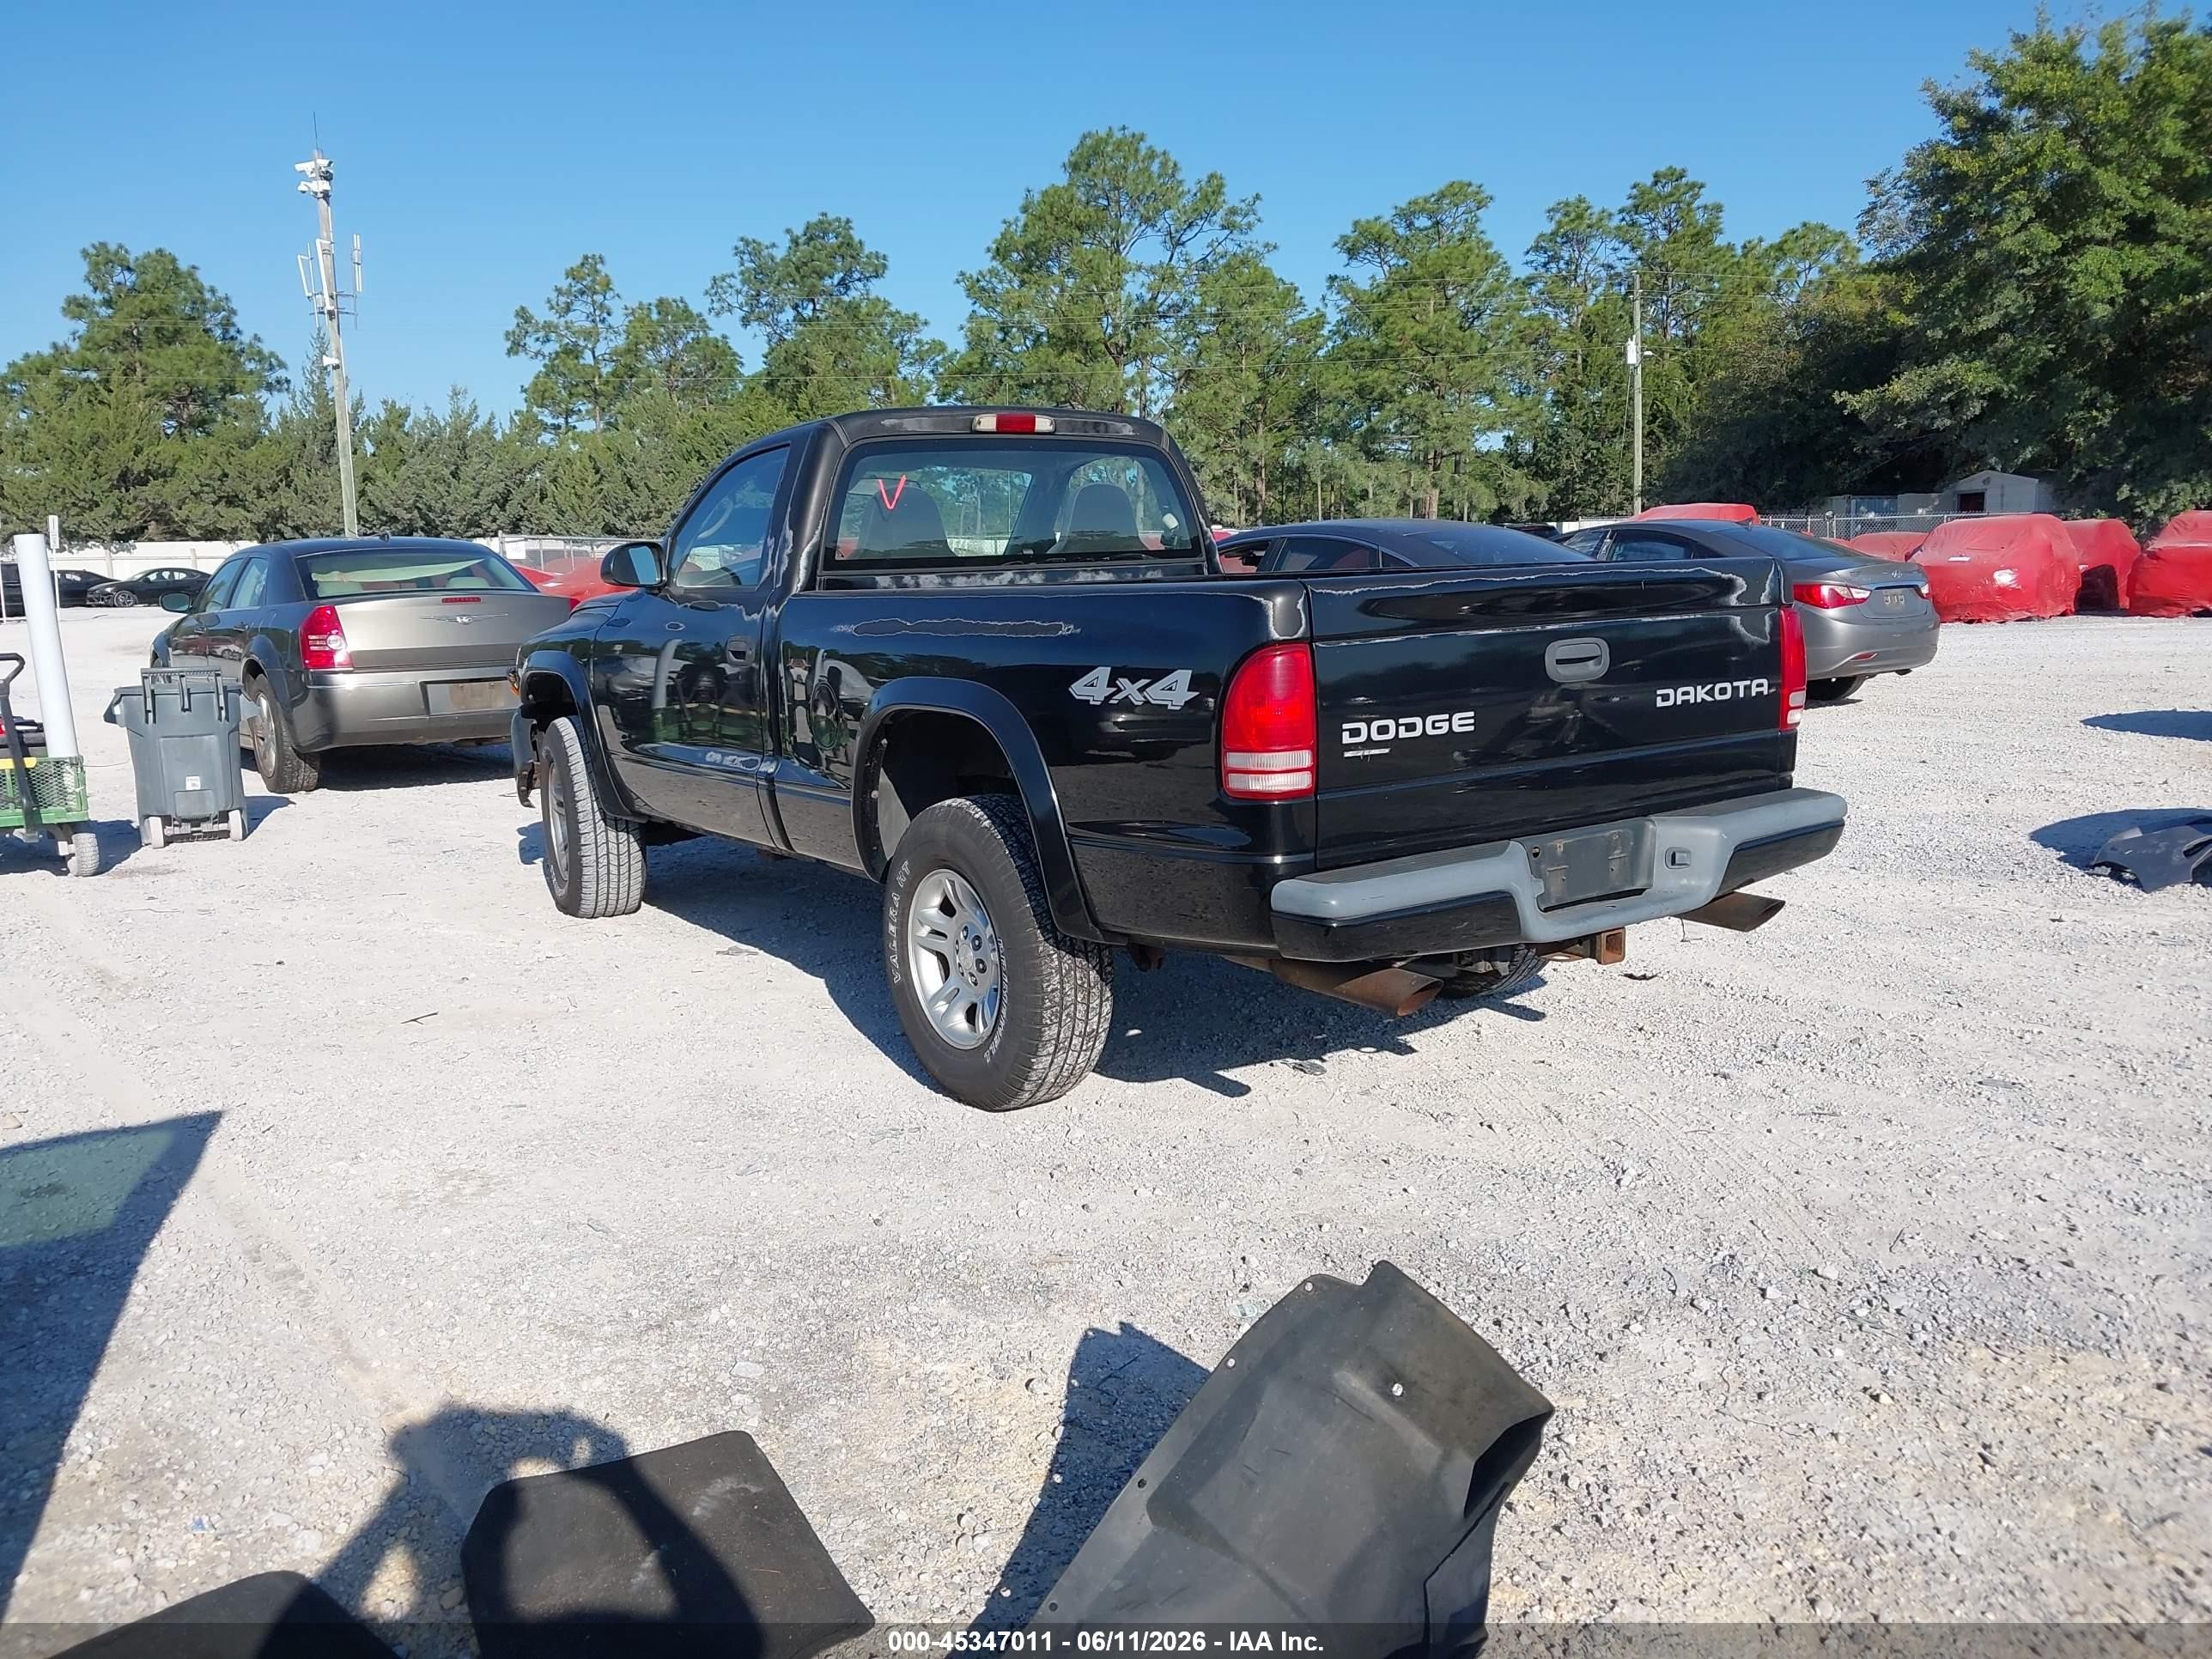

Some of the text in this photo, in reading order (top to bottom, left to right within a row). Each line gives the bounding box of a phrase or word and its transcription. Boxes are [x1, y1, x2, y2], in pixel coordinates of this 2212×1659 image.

[1068, 666, 1200, 710] 4x4
[1656, 678, 1769, 708] DAKOTA
[1341, 711, 1474, 744] DODGE
